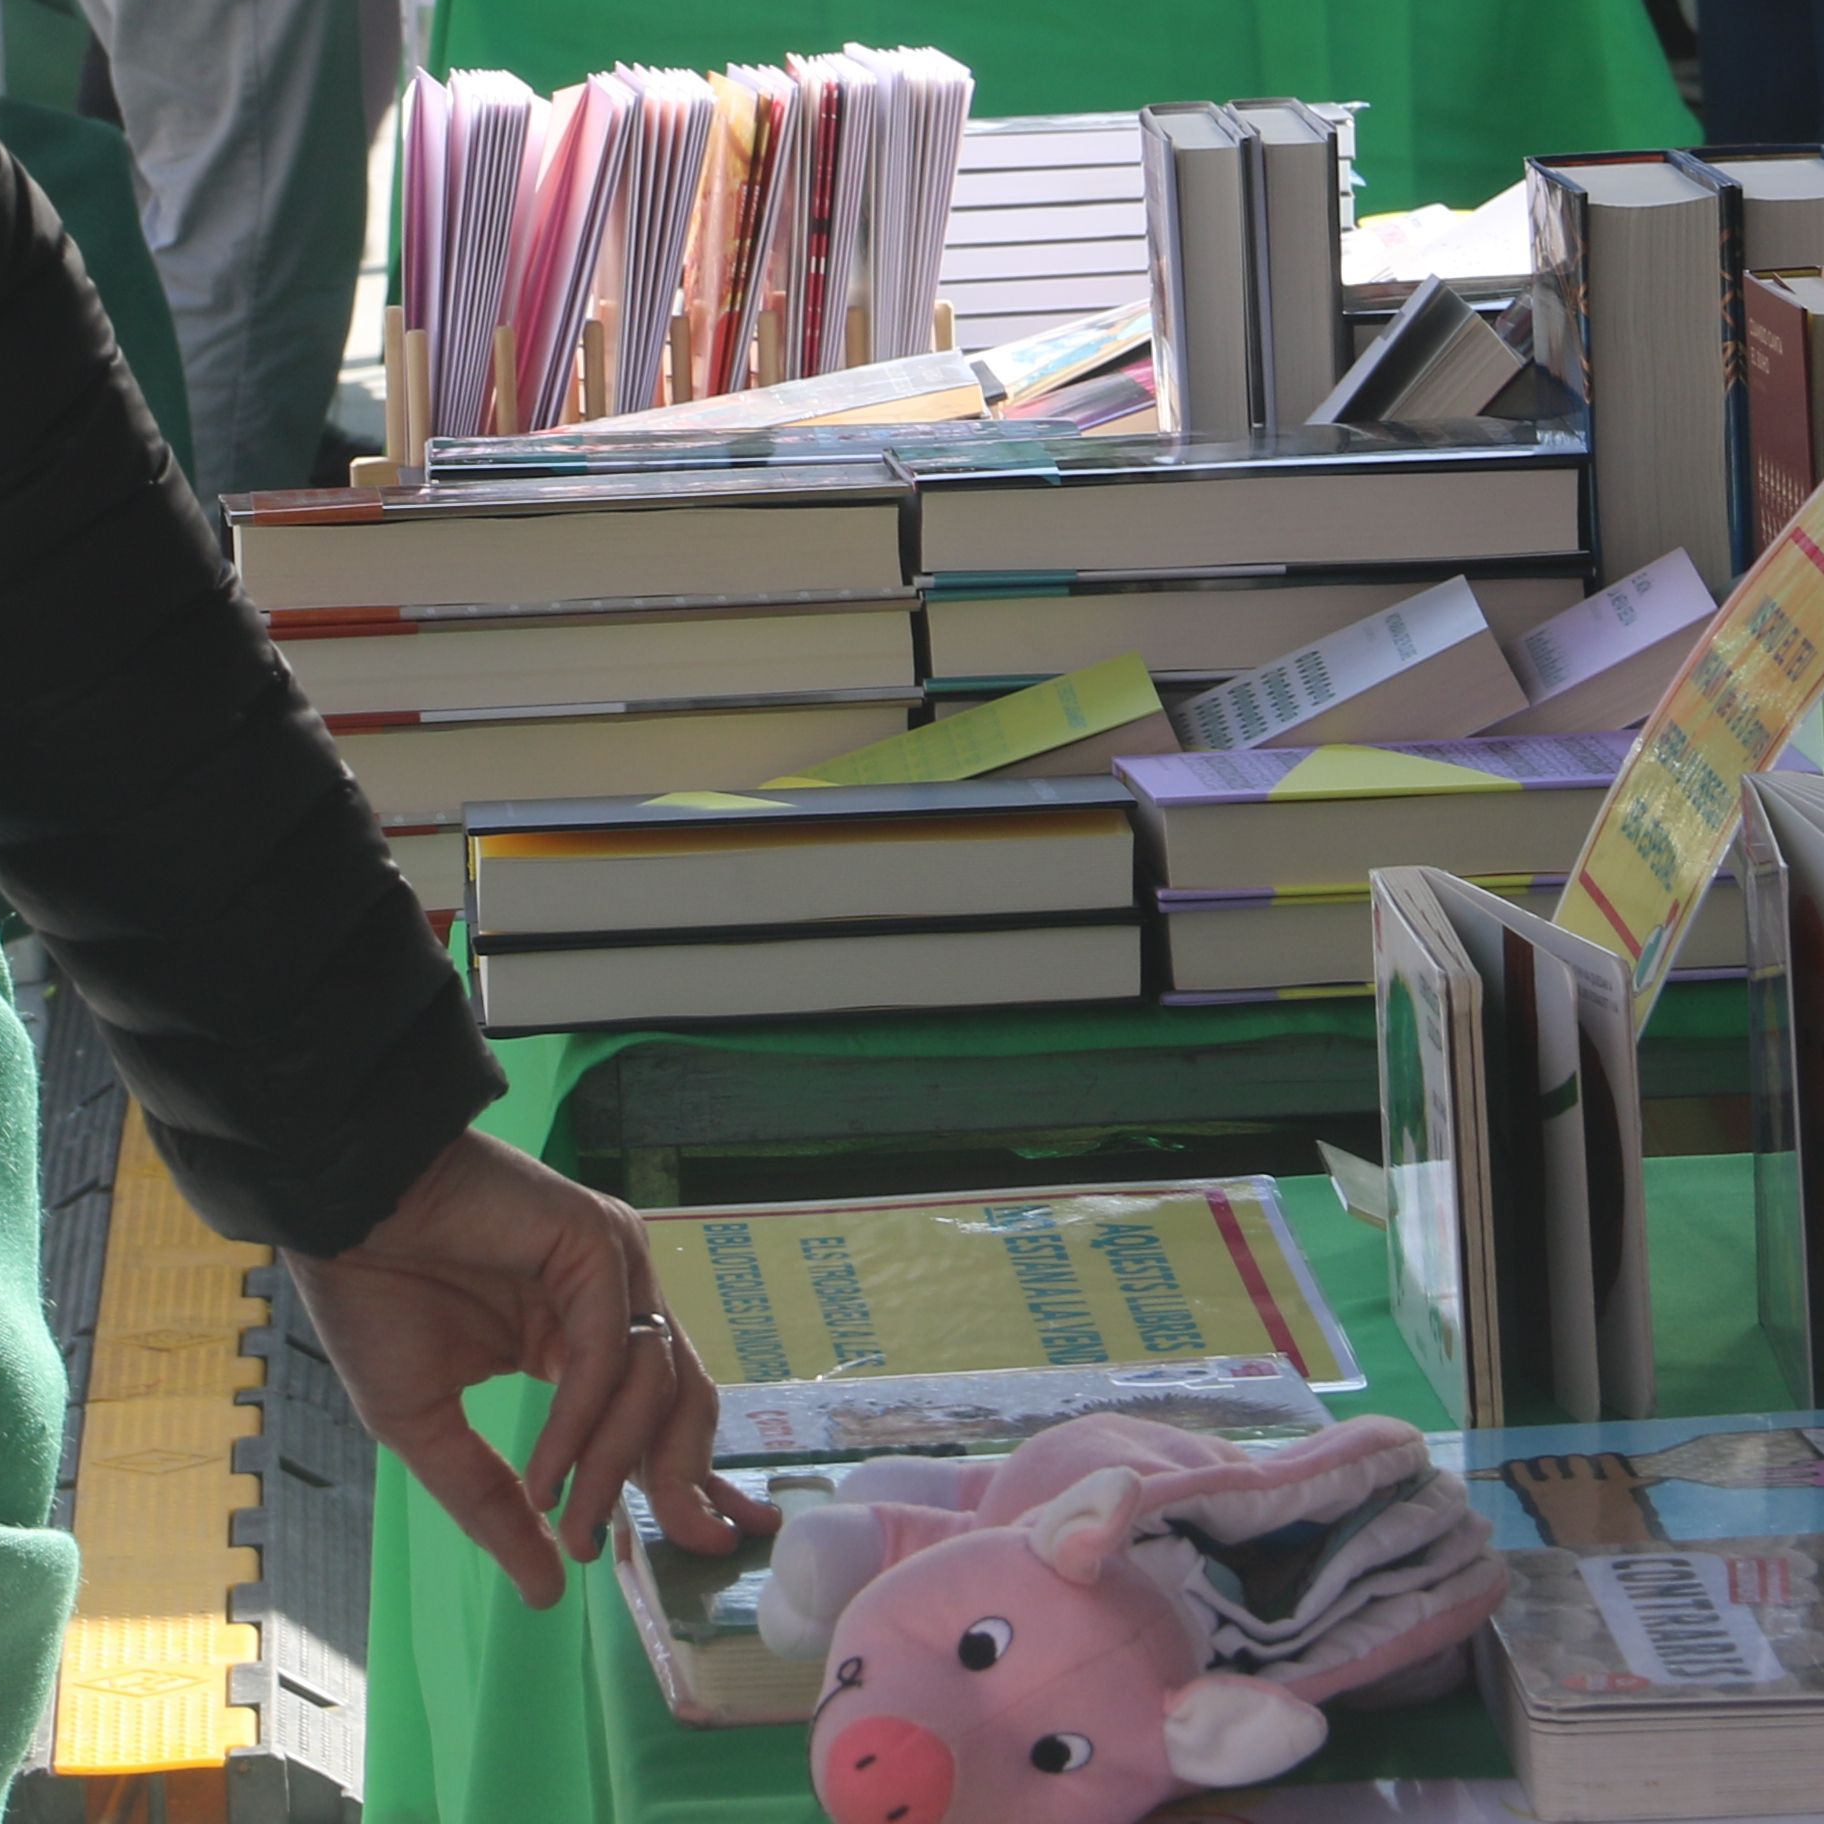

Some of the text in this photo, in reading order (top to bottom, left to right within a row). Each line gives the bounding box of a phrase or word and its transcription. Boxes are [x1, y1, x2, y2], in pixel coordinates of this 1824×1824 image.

[702, 1223, 772, 1314] BIBLIOTEQUES
[799, 1236, 851, 1262] ELS
[1003, 1233, 1079, 1285] ESTAN
[807, 1261, 875, 1328] TROBAREU
[1025, 1300, 1092, 1323] LA
[1090, 1222, 1207, 1353] AQUESTS LLIBRES
[1036, 1321, 1110, 1366] VEND
[1611, 1557, 1753, 1677] CONTRARIS
